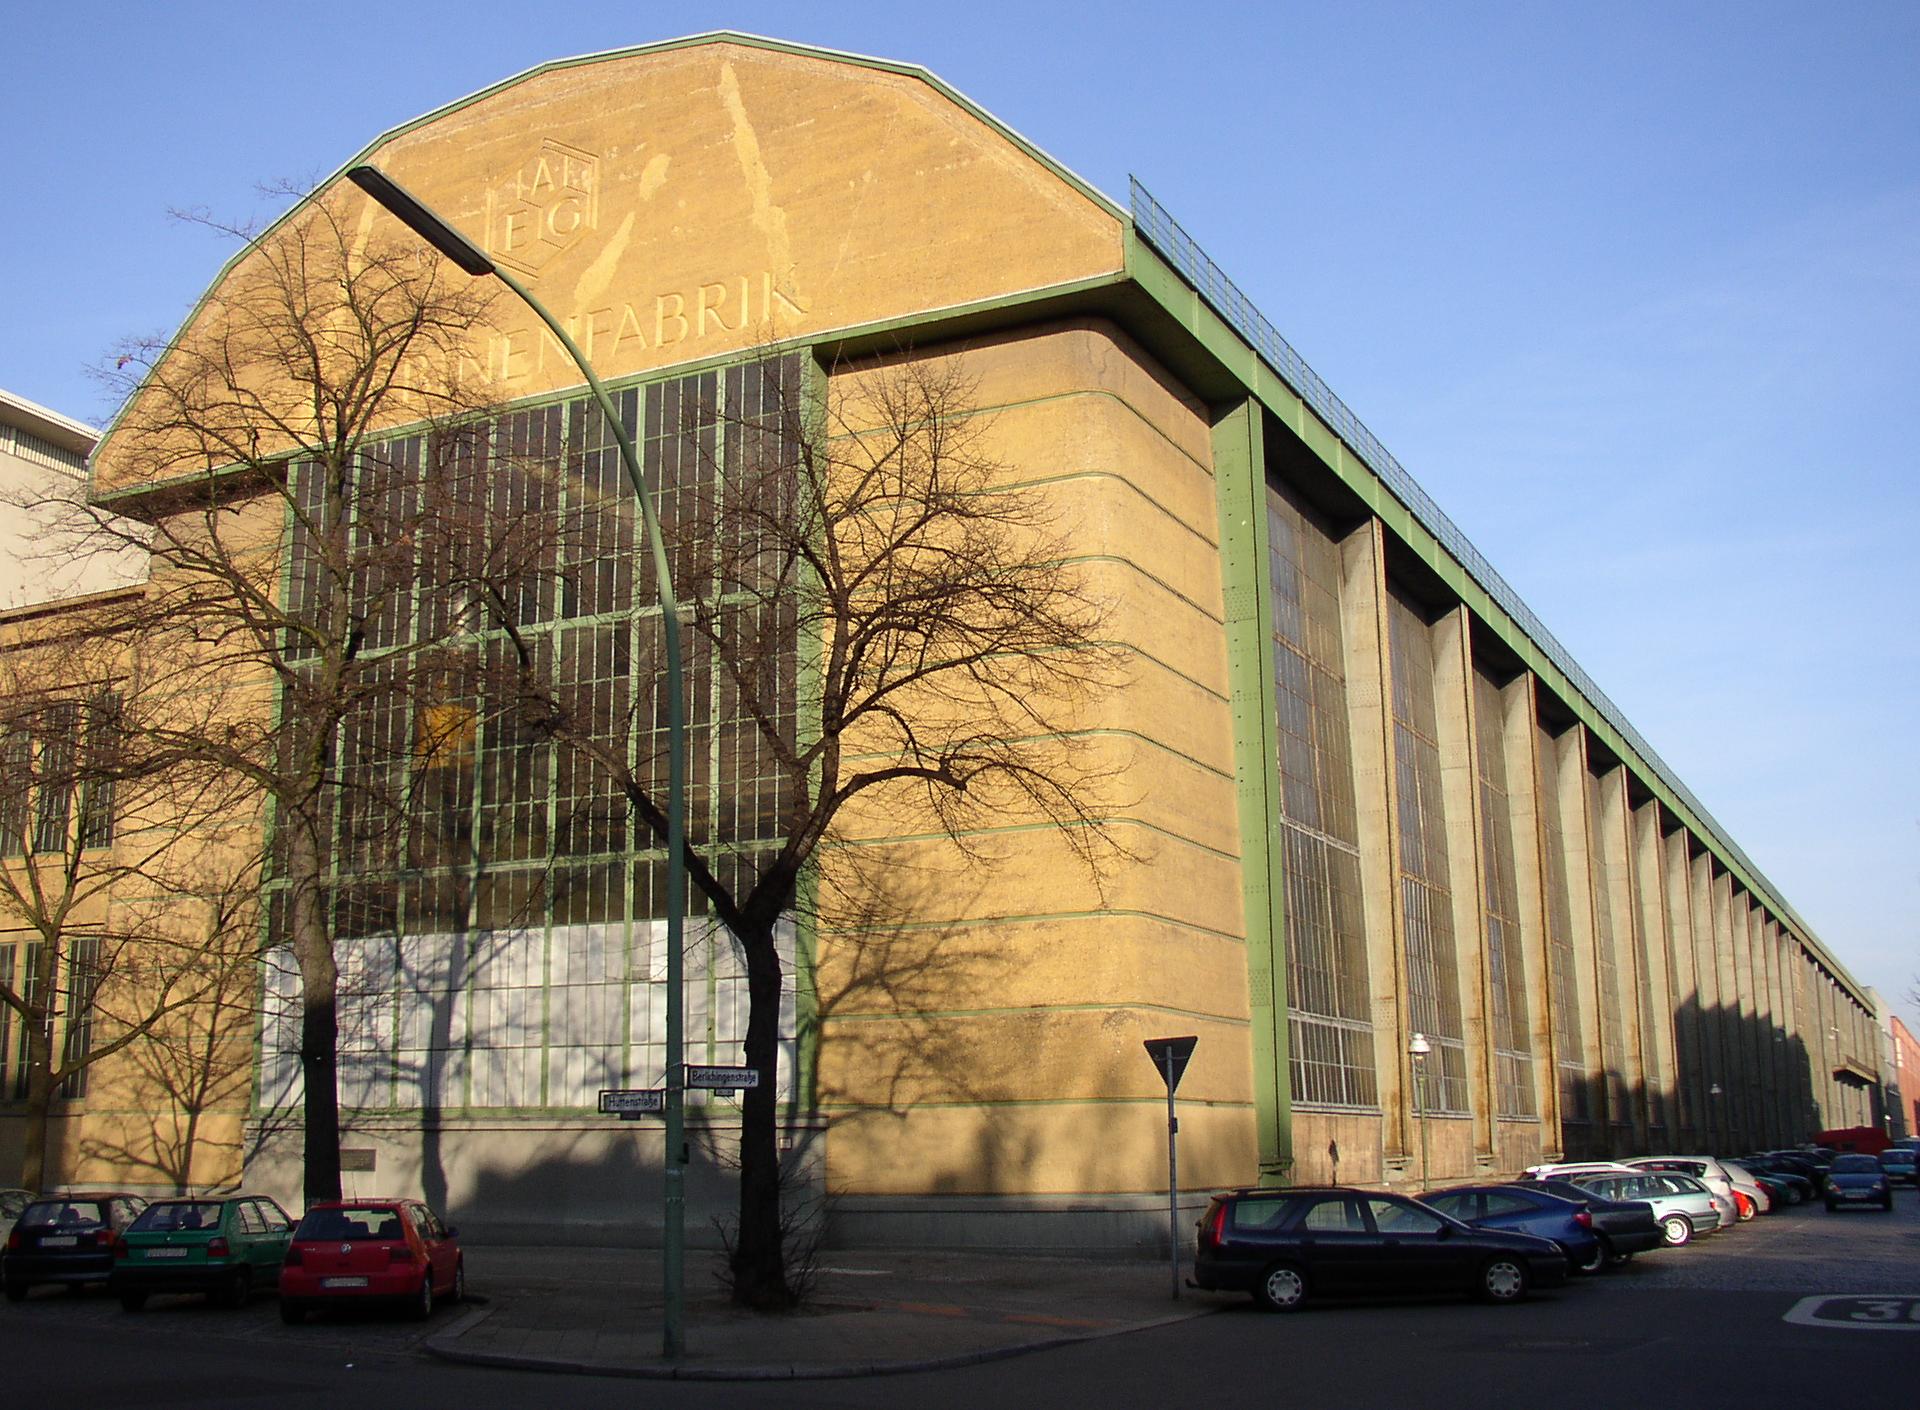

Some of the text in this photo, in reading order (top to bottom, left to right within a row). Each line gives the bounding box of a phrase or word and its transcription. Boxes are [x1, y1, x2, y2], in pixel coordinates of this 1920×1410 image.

[691, 1070, 757, 1085] Berlichingenstraße
[607, 1094, 658, 1108] Huttenstraße
[1850, 1300, 1920, 1322] 3
